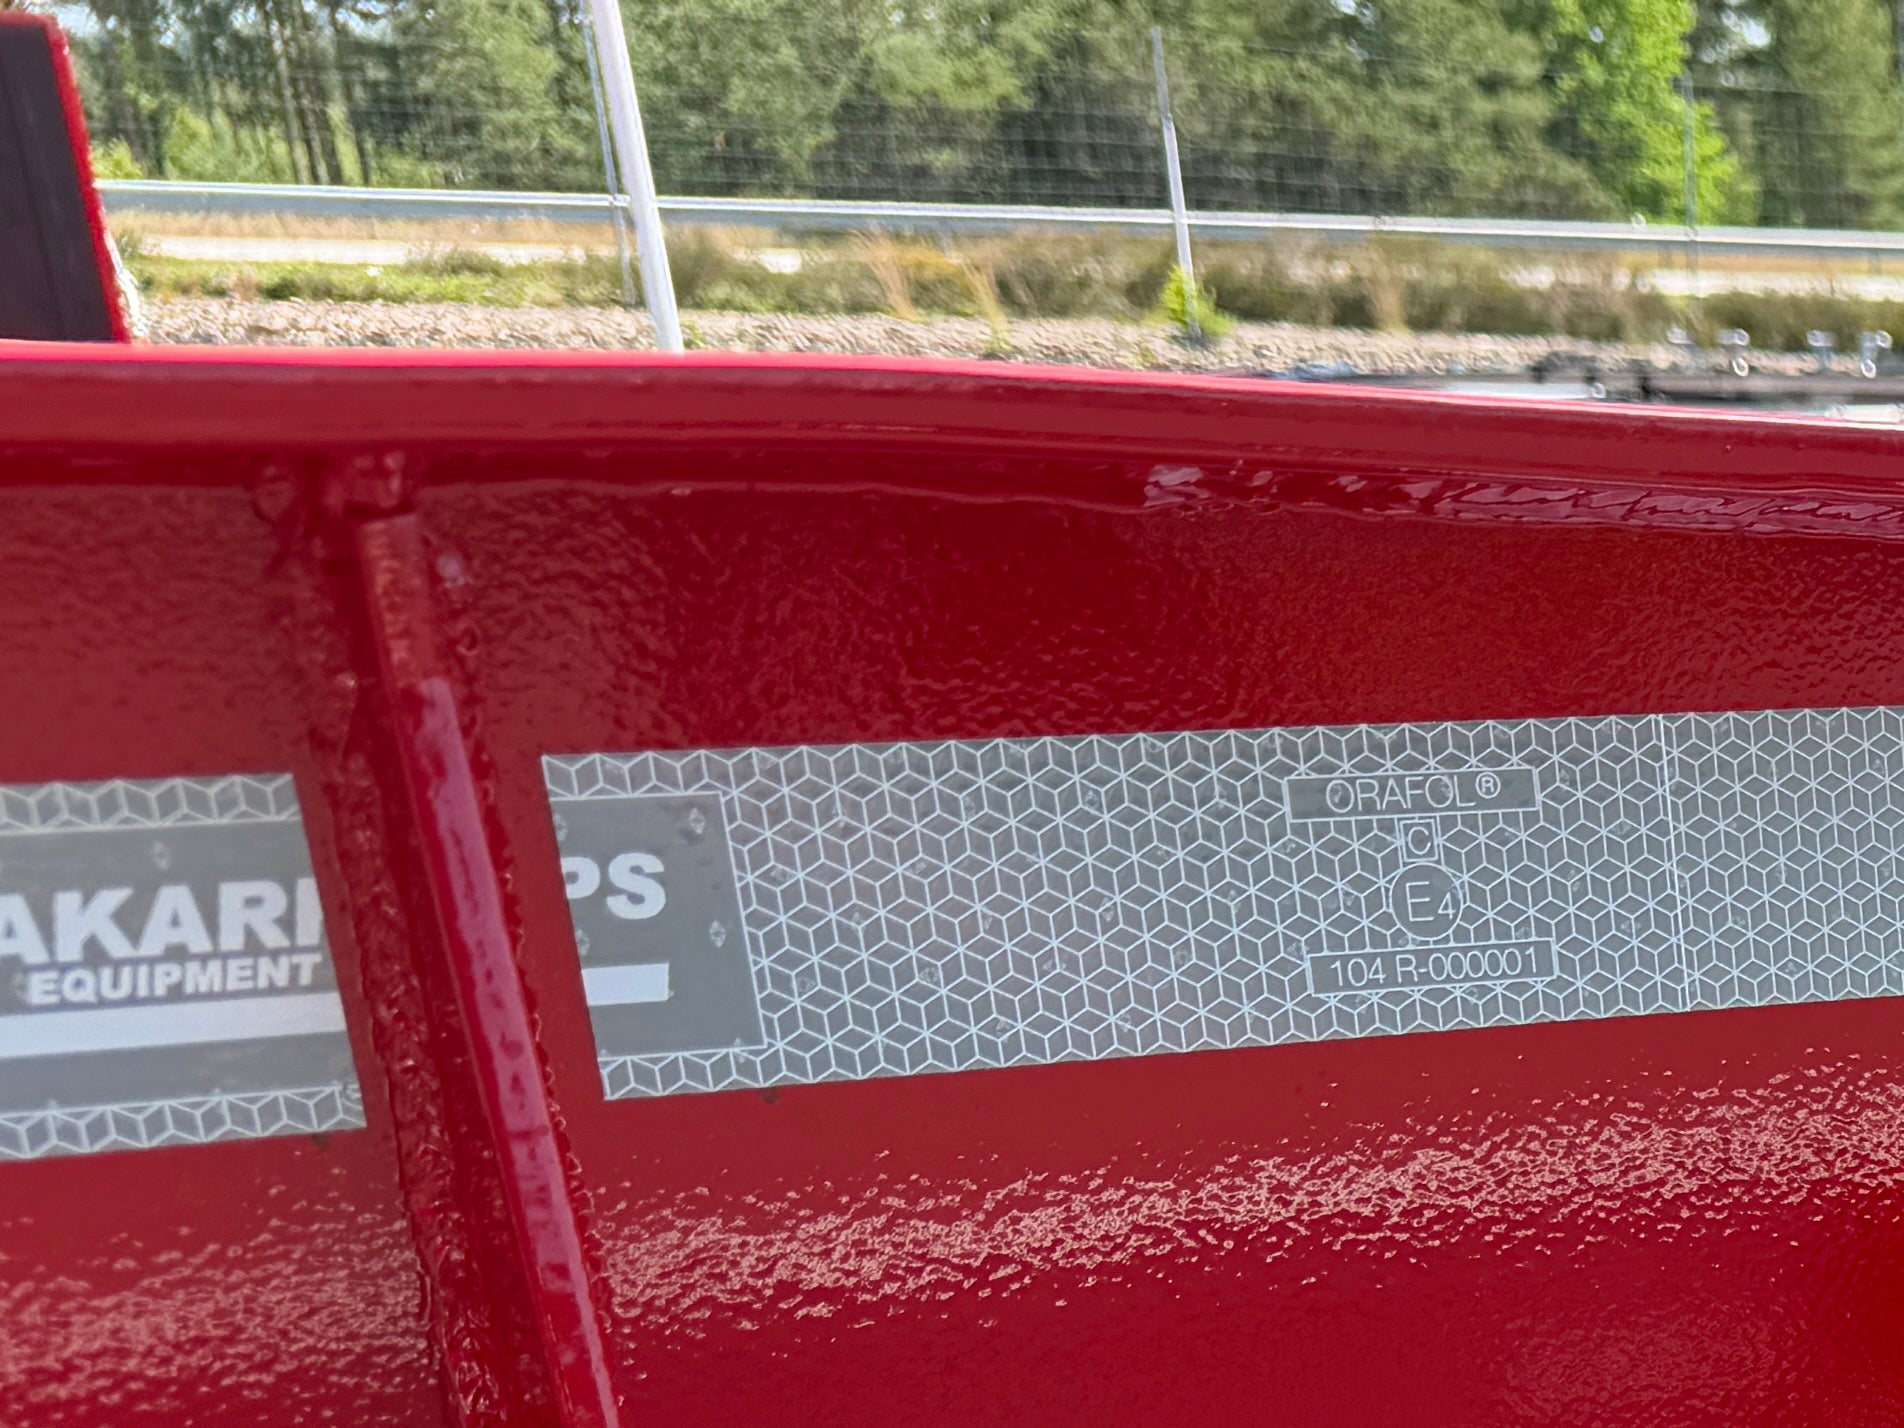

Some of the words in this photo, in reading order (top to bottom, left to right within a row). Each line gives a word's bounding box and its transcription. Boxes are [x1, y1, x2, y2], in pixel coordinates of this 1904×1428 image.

[1407, 826, 1431, 856] C
[28, 953, 322, 1006] EQUIPMENT
[1330, 957, 1387, 987] 104
[1396, 946, 1537, 983] R-000001
